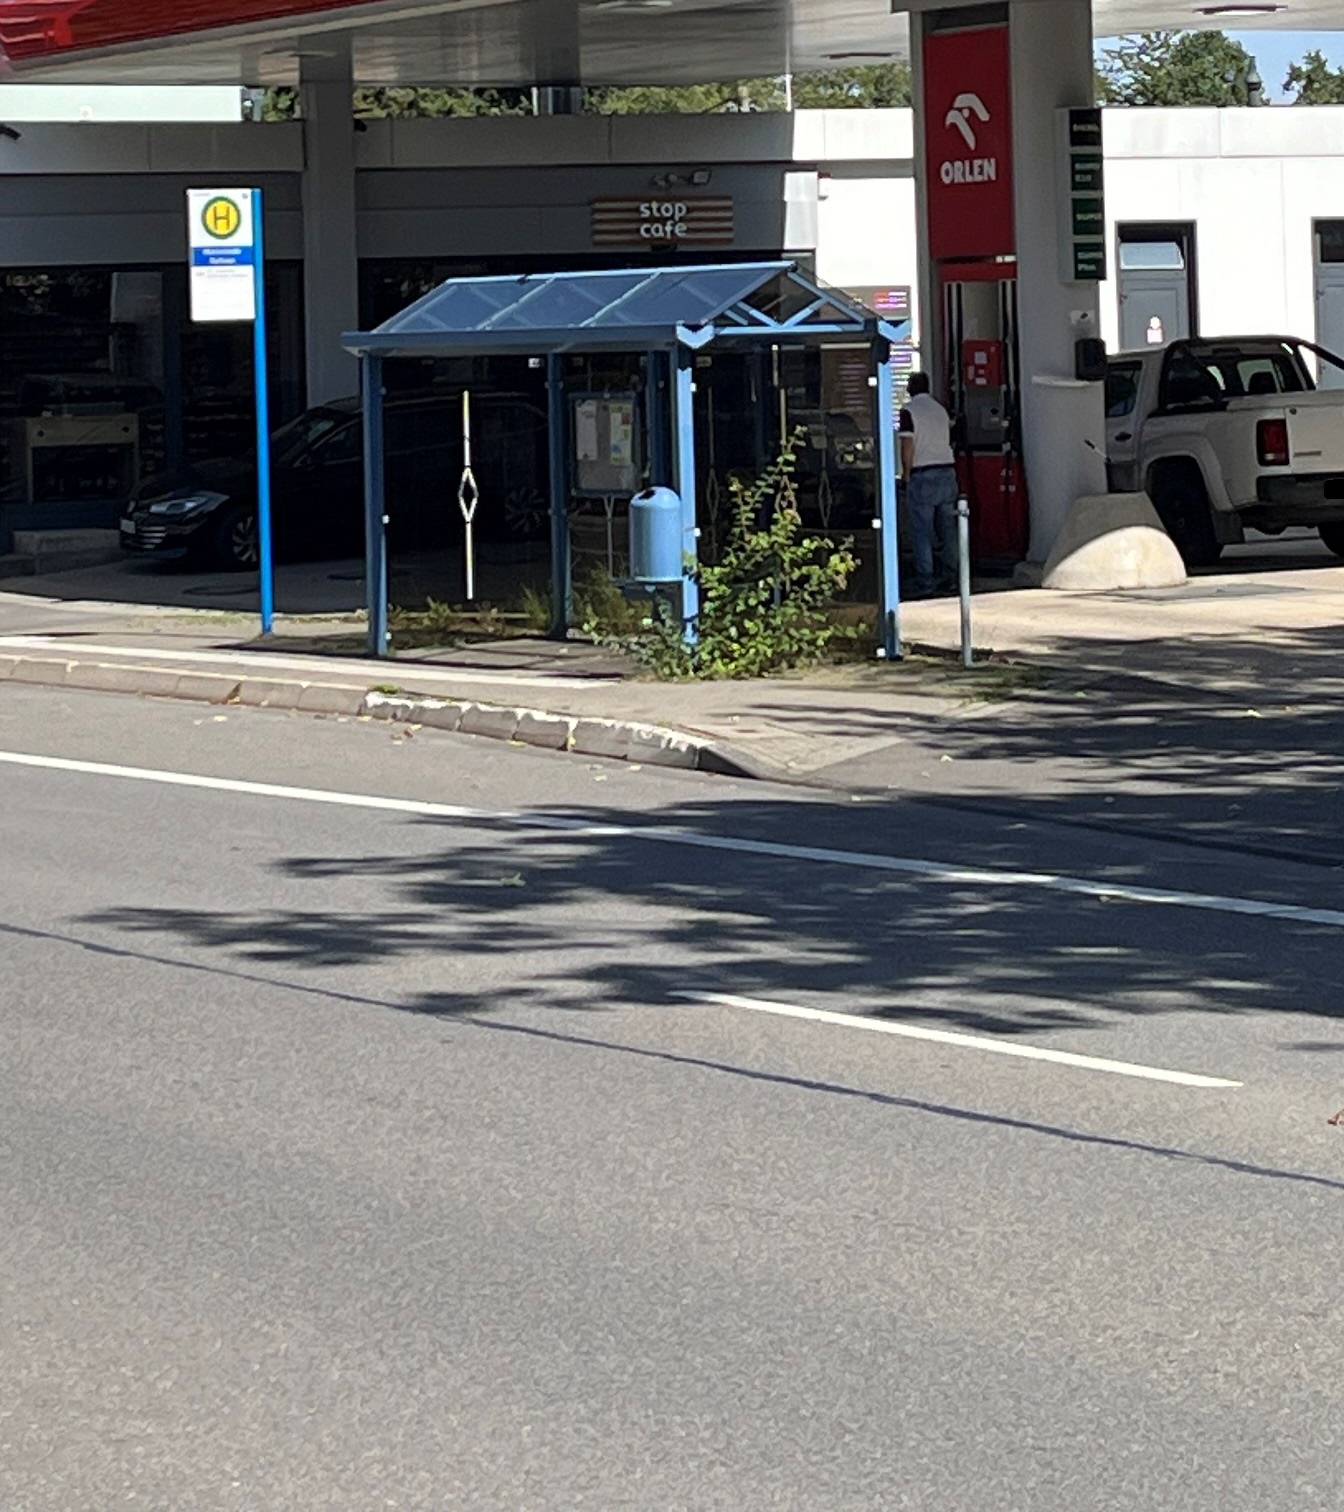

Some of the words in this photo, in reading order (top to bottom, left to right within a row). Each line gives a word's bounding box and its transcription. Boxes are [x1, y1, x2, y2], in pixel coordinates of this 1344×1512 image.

[940, 157, 997, 185] ORLEN
[213, 205, 230, 230] H
[639, 200, 688, 221] stop
[639, 220, 689, 240] cafe
